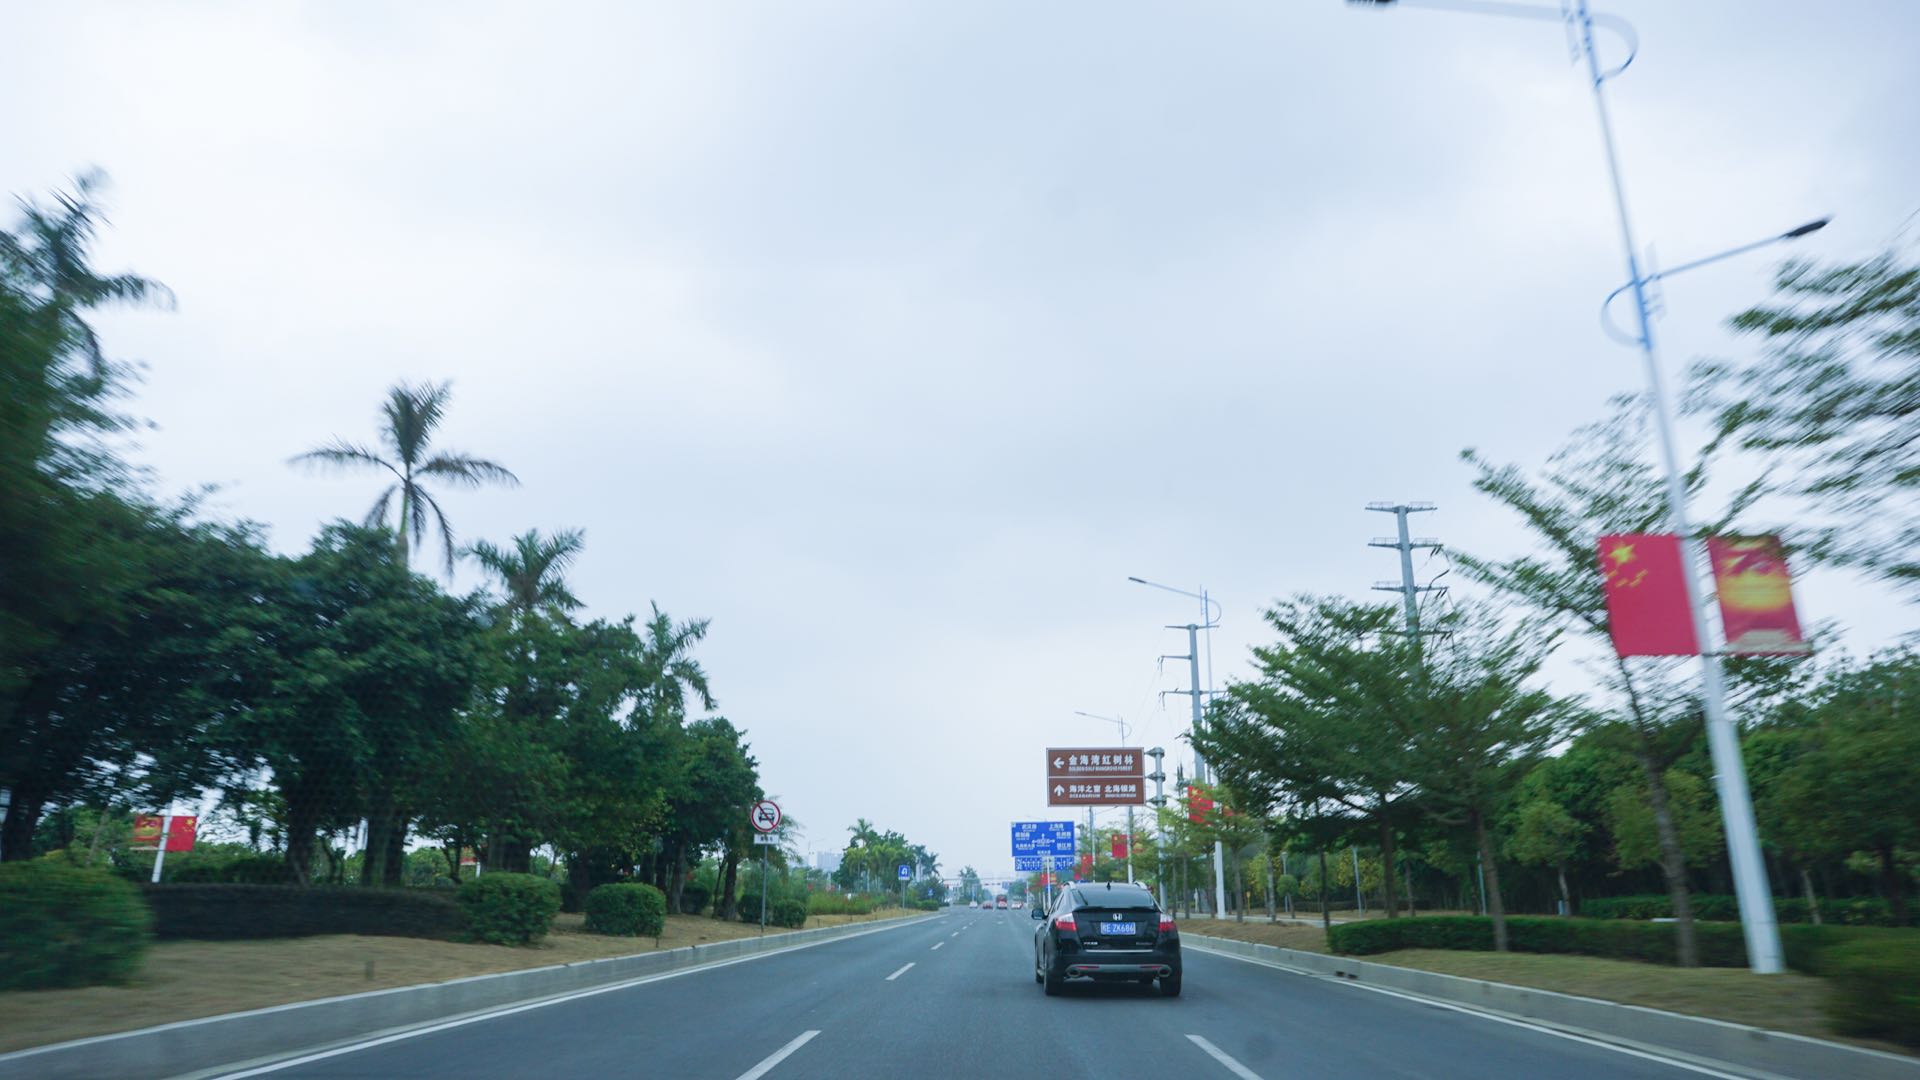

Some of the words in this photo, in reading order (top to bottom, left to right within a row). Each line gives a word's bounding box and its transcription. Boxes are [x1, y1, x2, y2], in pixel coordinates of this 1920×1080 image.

[1068, 755, 1134, 765] 金海湾红树林
[1069, 784, 1101, 793] 海洋之窗
[1104, 784, 1136, 793] 北海银滩
